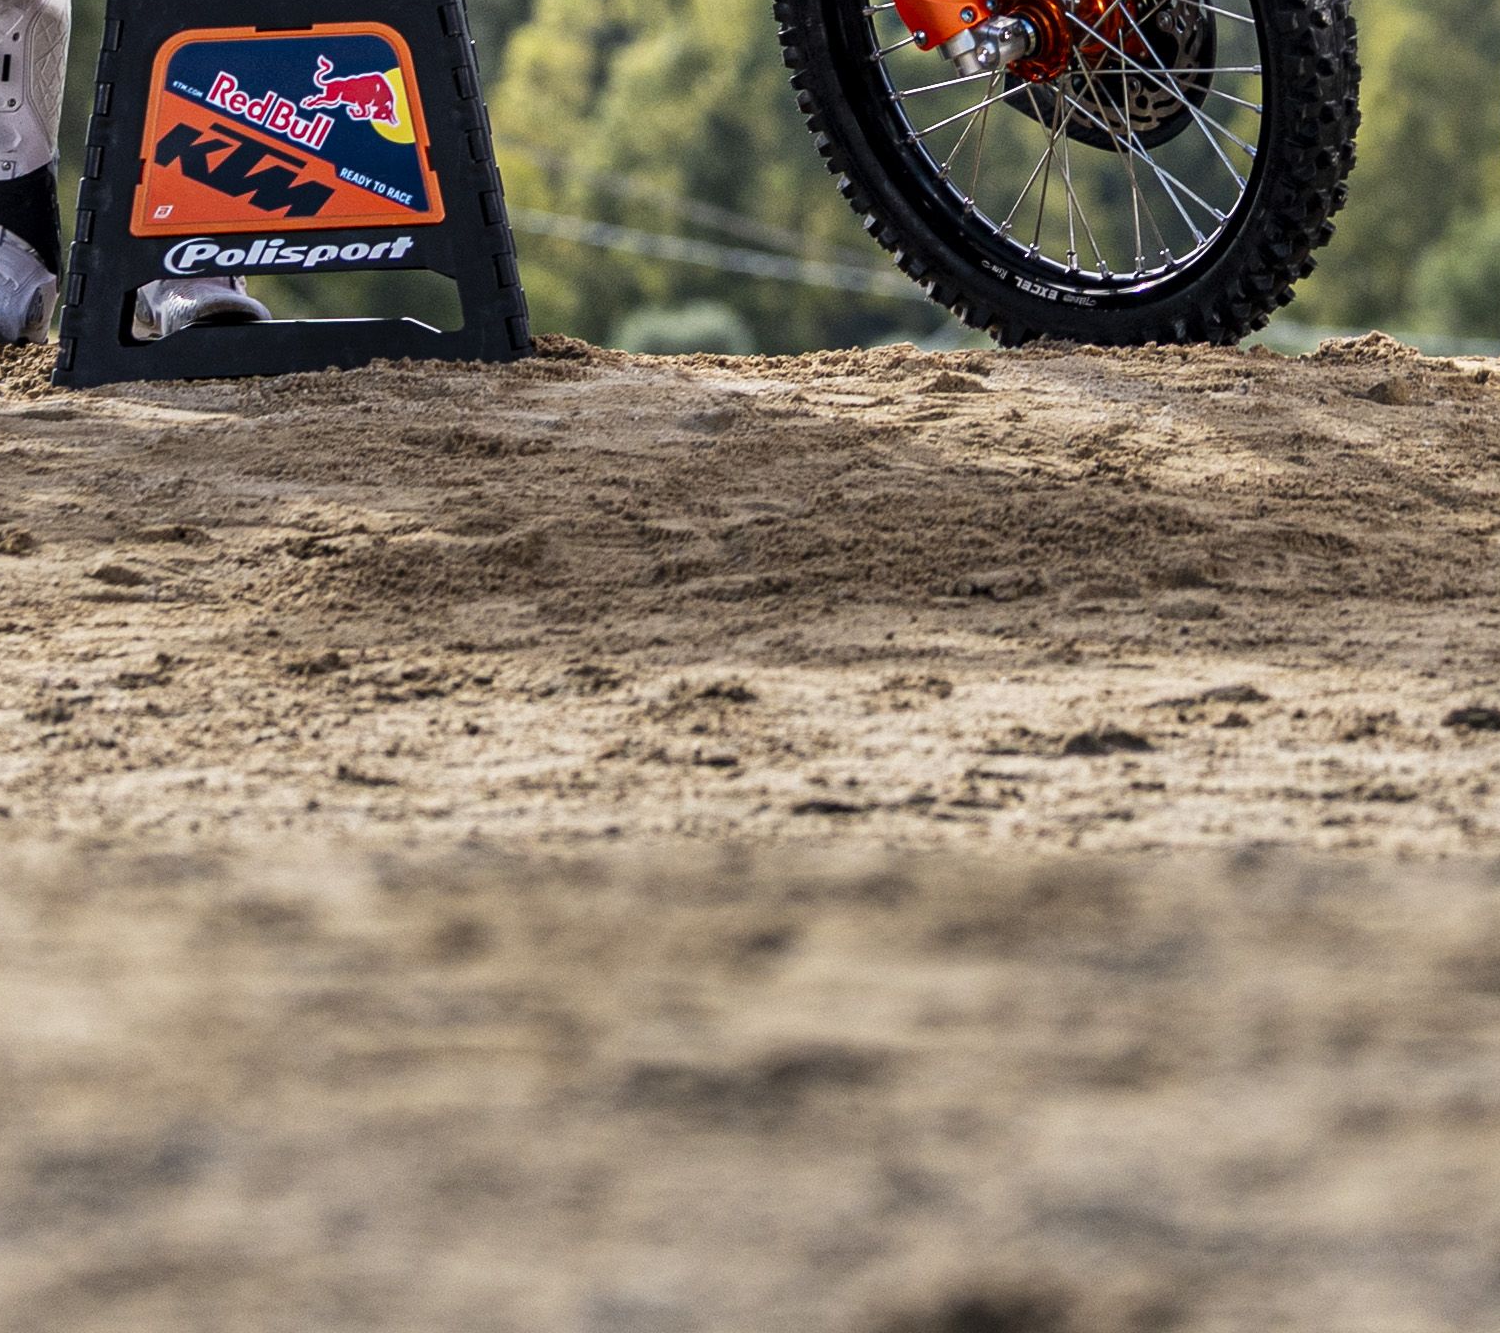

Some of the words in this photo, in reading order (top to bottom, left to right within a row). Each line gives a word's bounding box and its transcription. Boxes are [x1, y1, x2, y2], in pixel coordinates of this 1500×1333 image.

[172, 81, 203, 98] KTM.COM
[206, 71, 275, 123] Red
[267, 101, 335, 150] Bull
[155, 122, 335, 218] KTM
[340, 167, 372, 188] READY
[373, 180, 387, 195] TO
[386, 185, 413, 205] RACE
[175, 236, 414, 269] Polisport
[1014, 275, 1059, 301] EXCEL
